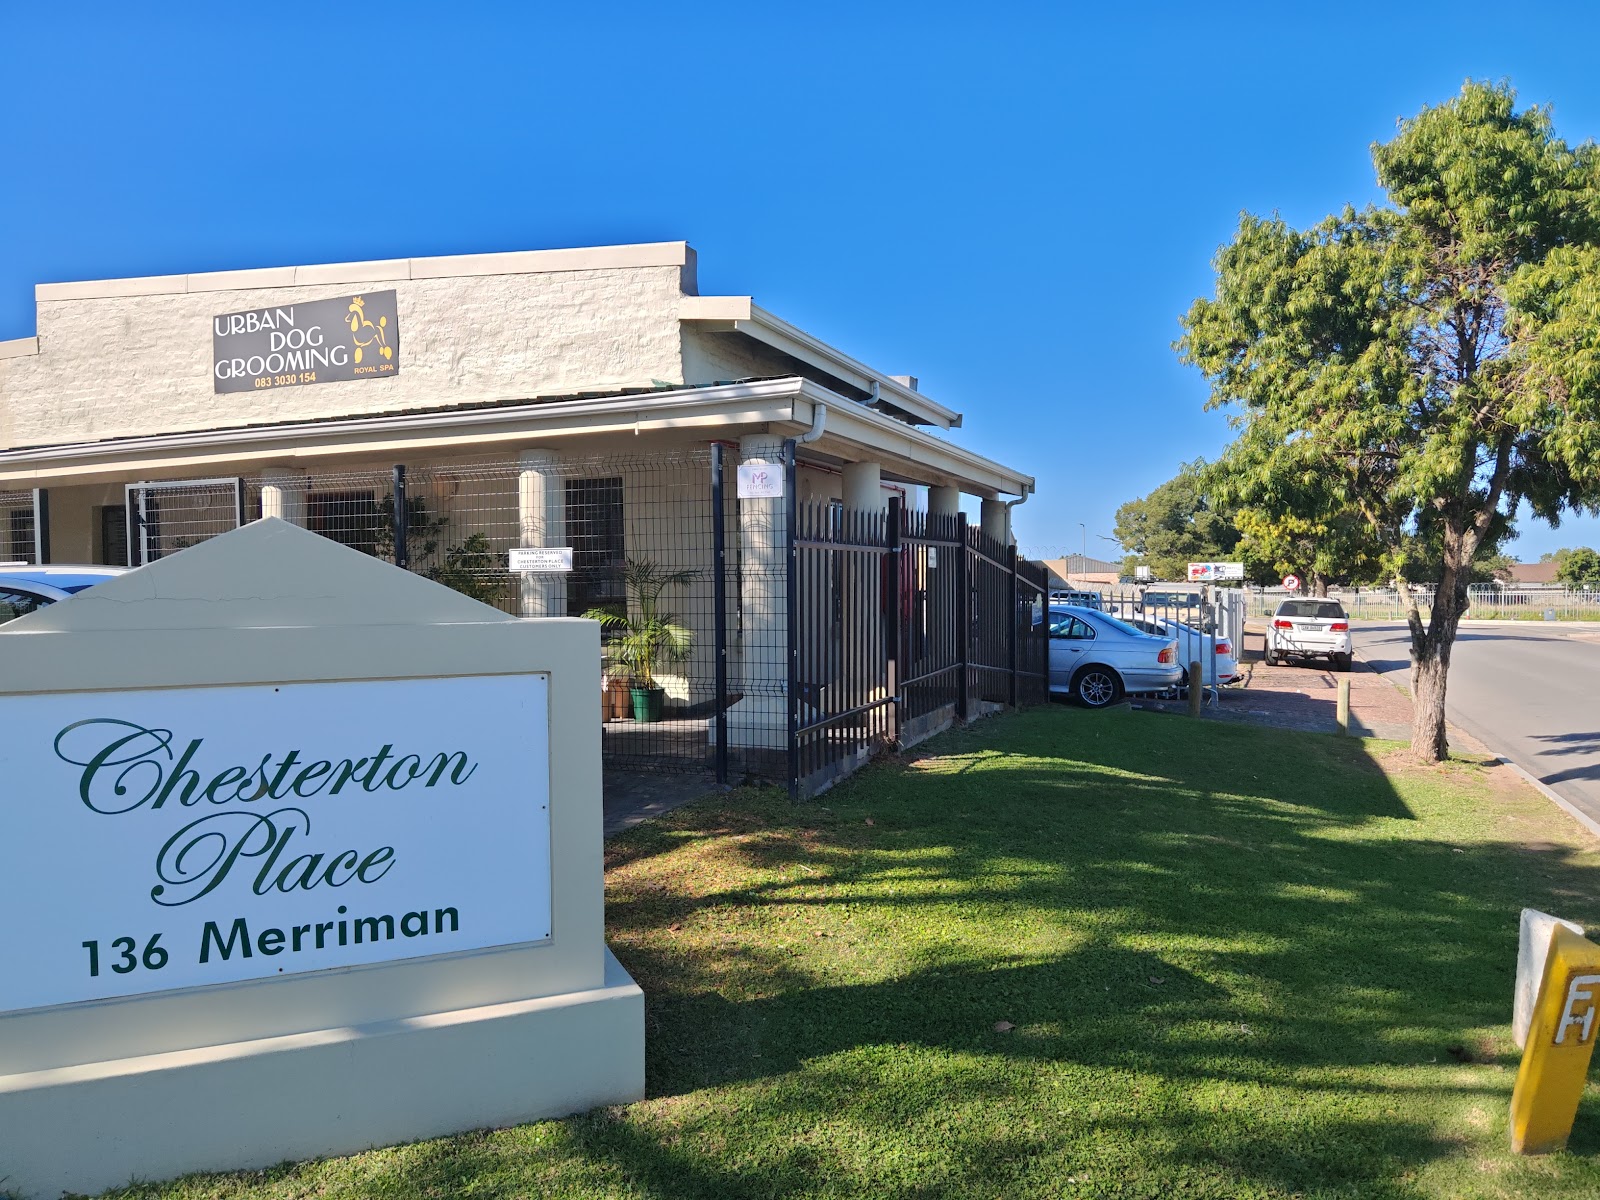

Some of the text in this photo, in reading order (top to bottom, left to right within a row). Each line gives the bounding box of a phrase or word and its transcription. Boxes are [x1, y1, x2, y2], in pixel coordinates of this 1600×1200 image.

[214, 306, 295, 337] URBAN
[270, 326, 324, 352] DOG
[214, 345, 348, 379] GROOMING
[354, 364, 394, 375] ROYAL SPA
[254, 371, 317, 388] 083 3030 154
[53, 718, 479, 816] Chesterton
[150, 807, 396, 907] Place
[81, 905, 459, 977] 136 Merriman
